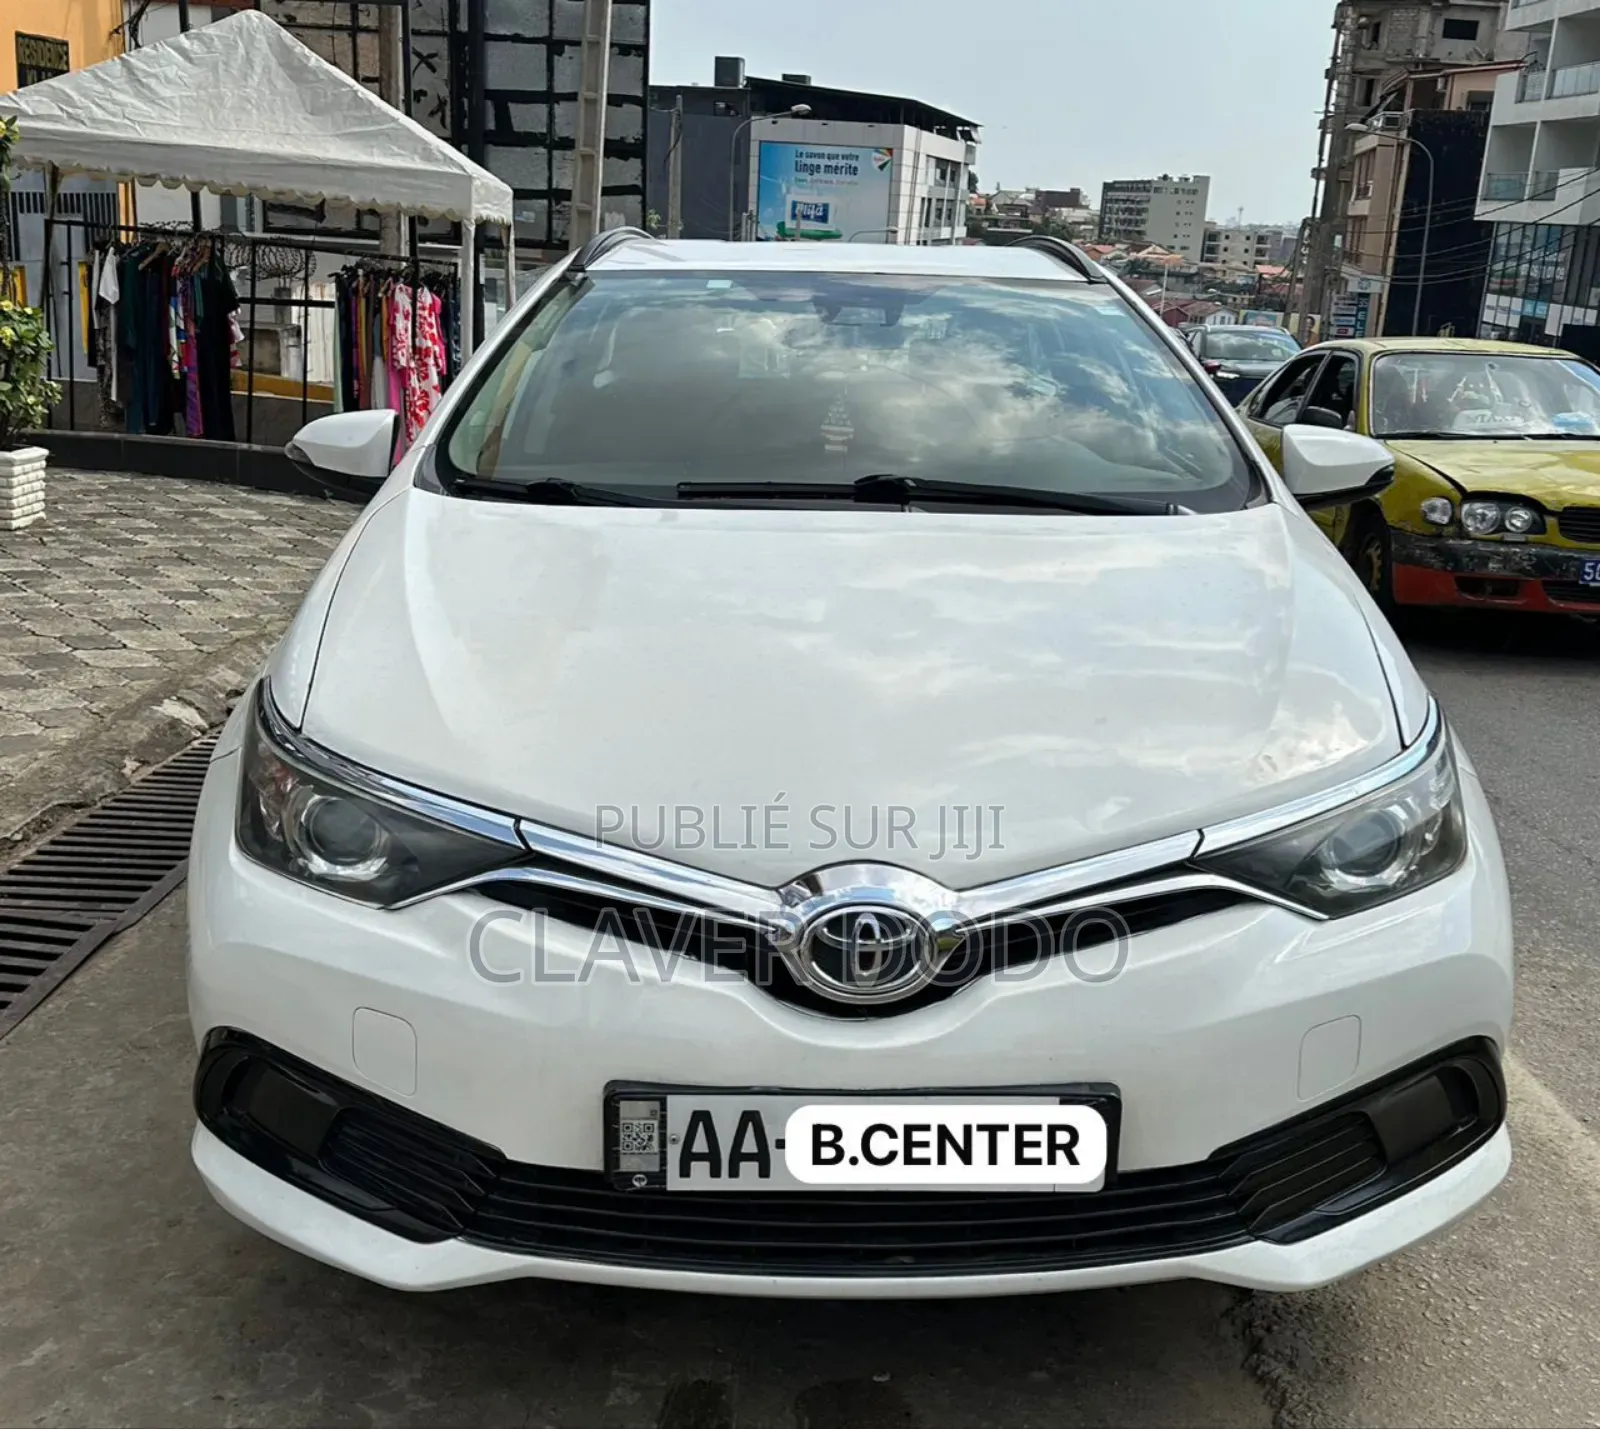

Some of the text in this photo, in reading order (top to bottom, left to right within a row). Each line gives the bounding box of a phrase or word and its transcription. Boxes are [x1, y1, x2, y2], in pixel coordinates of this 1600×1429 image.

[795, 150, 860, 162] Le savon que votre
[823, 162, 859, 176] mérite
